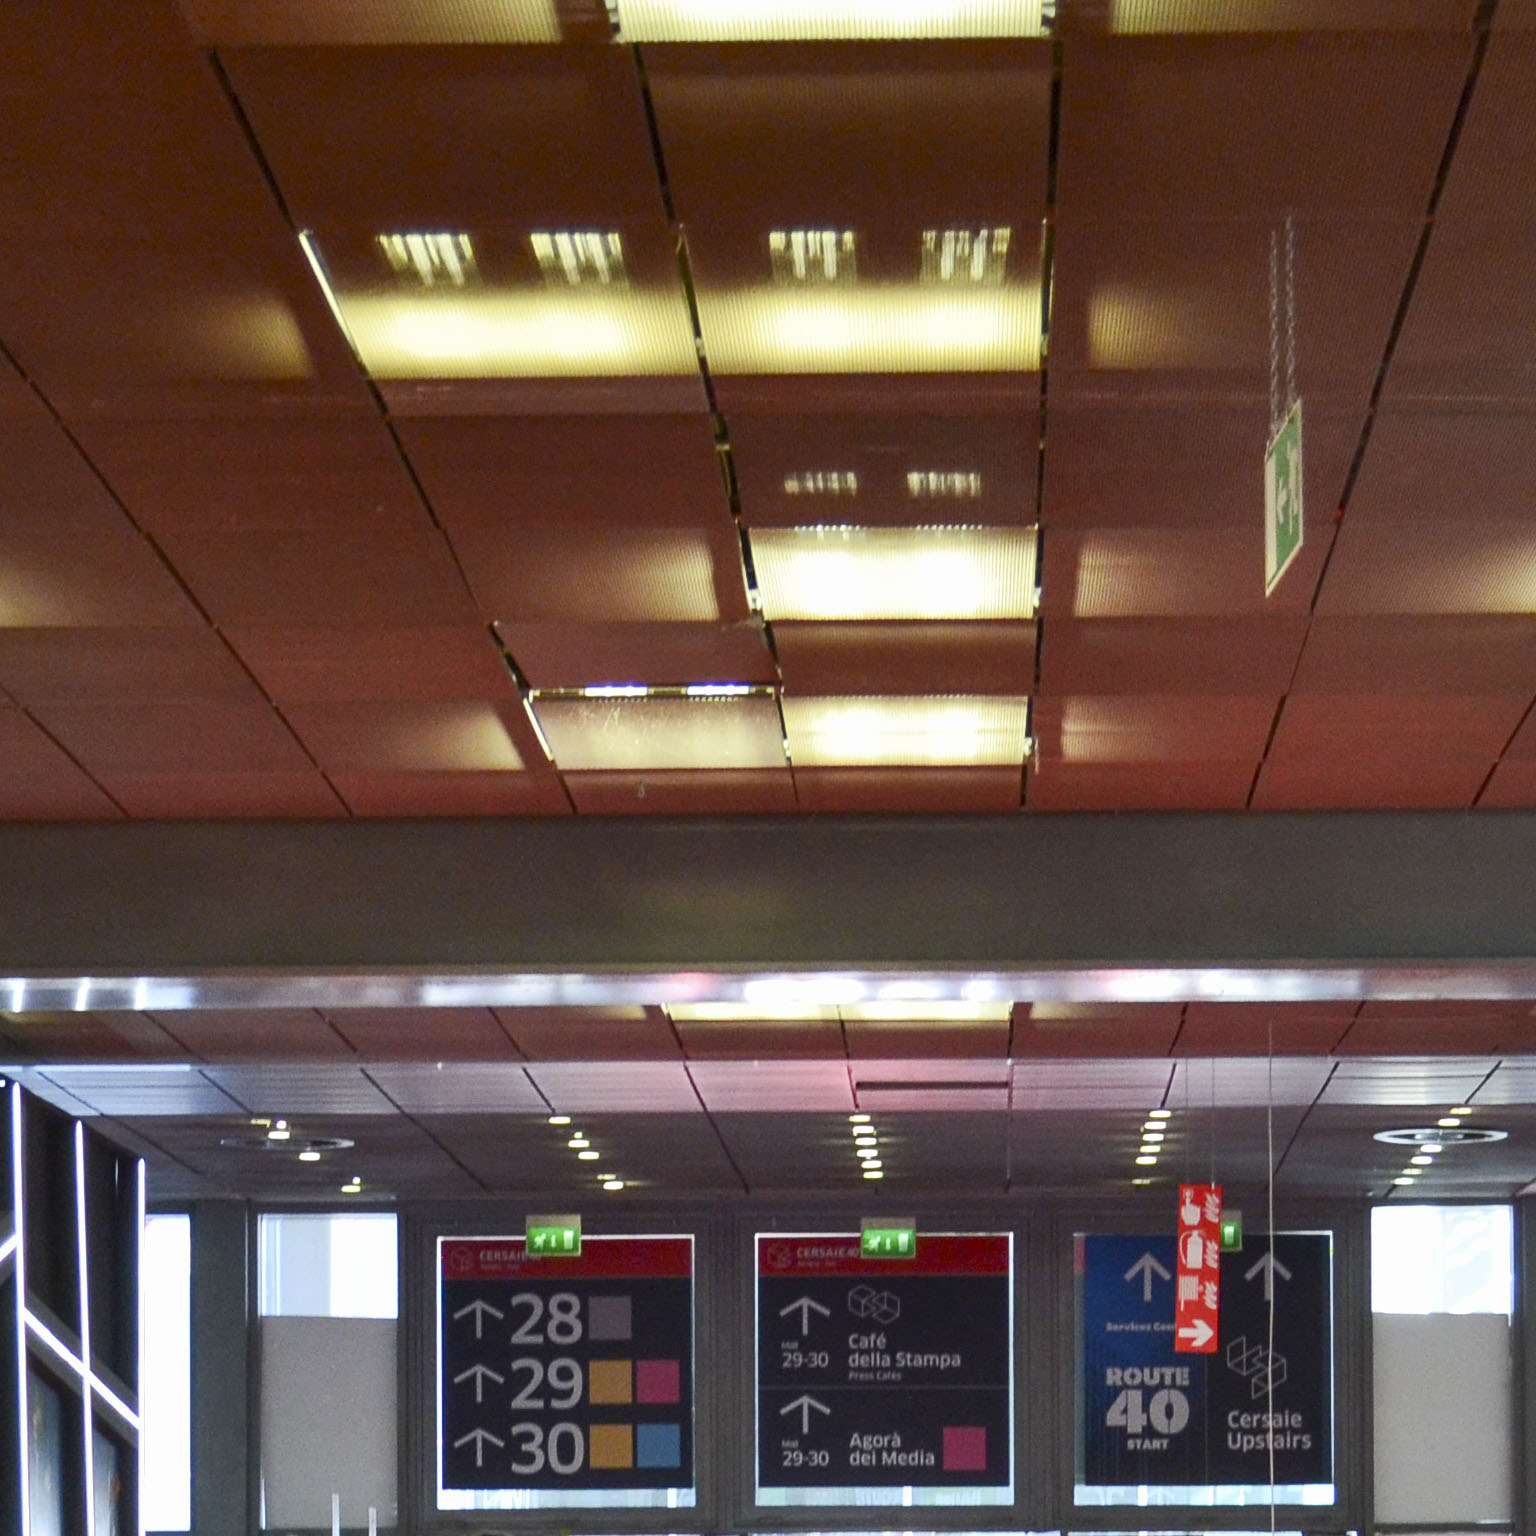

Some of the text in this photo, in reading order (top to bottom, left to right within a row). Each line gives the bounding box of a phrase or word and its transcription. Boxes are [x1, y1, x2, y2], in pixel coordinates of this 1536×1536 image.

[510, 1292, 583, 1345] 28
[848, 1333, 886, 1350] Café
[782, 1351, 829, 1368] 29-30
[848, 1351, 961, 1371] della Stampa
[510, 1357, 584, 1410] 29
[1106, 1366, 1190, 1386] ROUTE
[1106, 1389, 1190, 1435] 40
[1227, 1409, 1302, 1430] Cersaie
[511, 1421, 585, 1475] 30
[849, 1431, 901, 1451] Agorà
[1127, 1439, 1170, 1450] START
[1227, 1431, 1312, 1453] Upstairs
[782, 1451, 830, 1468] 29-30
[849, 1450, 935, 1467] dei Media
